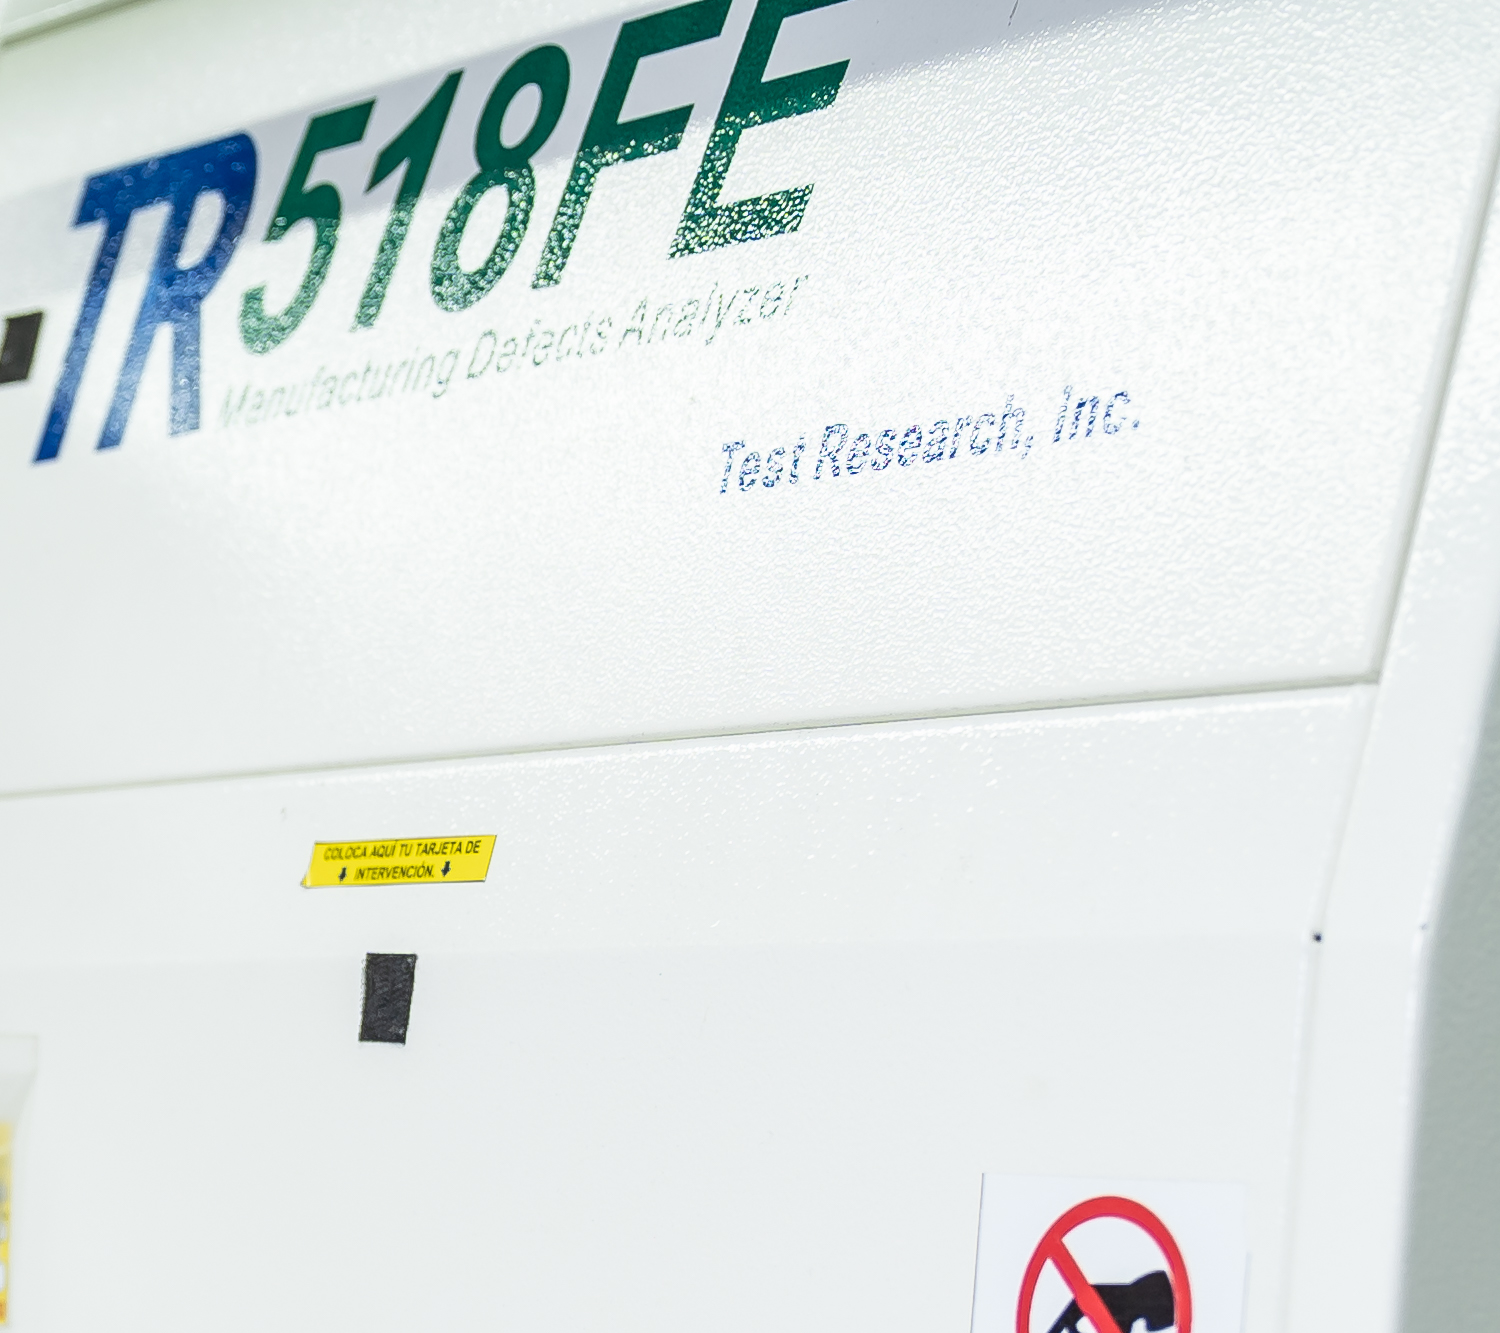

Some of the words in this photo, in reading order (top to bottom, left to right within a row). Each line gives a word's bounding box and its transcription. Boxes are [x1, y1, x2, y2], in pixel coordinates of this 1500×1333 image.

[220, 346, 461, 430] Manufacturing
[465, 310, 614, 381] Defects
[618, 274, 810, 349] Analyzer
[720, 432, 807, 494] Test
[813, 394, 1034, 481] Research,
[1052, 385, 1140, 444] Inc.
[323, 844, 367, 861] COLOCA
[399, 843, 413, 857] TU
[416, 842, 462, 856] TARJETA
[465, 840, 482, 854] DE
